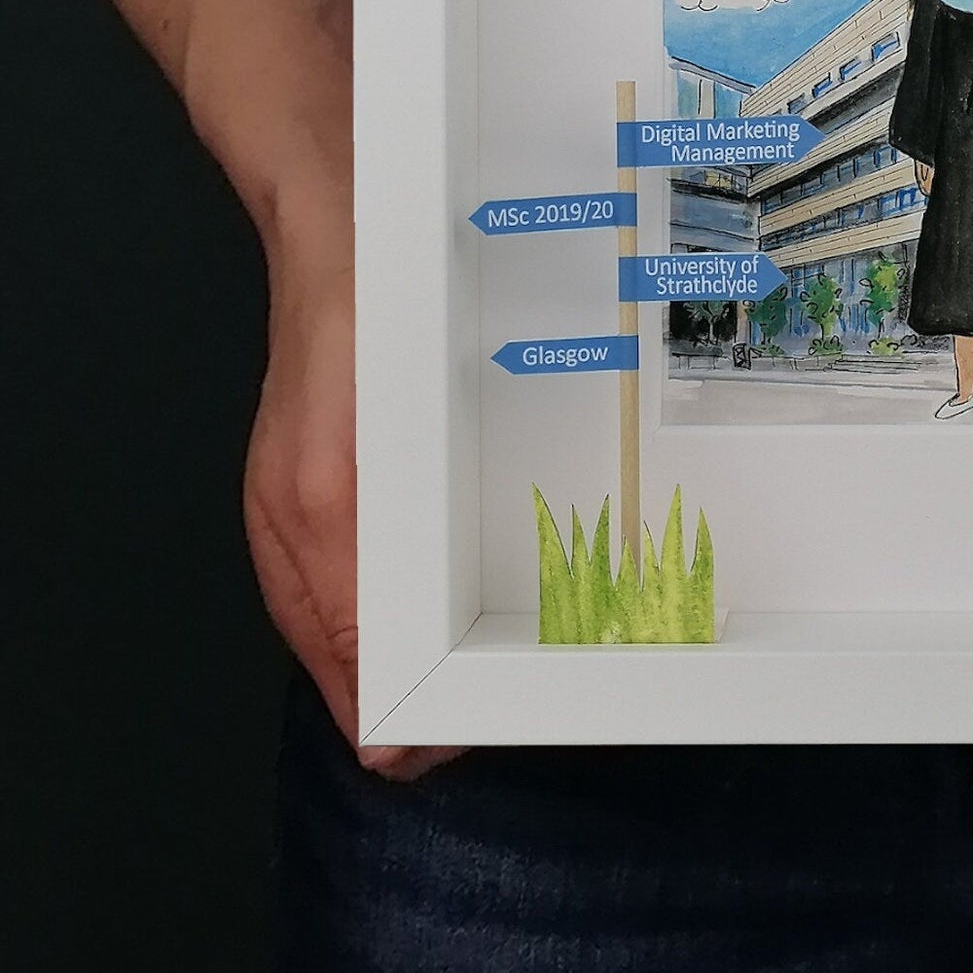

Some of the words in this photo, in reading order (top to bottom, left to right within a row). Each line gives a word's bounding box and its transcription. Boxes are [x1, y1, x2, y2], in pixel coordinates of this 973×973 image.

[641, 123, 701, 146] Digital
[707, 119, 801, 144] Marketing
[671, 141, 796, 165] Management
[488, 207, 531, 227] MSc
[534, 199, 615, 226] 2019/20
[645, 257, 736, 279] University
[740, 254, 760, 275] of
[656, 274, 759, 297] Strathclyde
[521, 345, 609, 369] Glasgow
